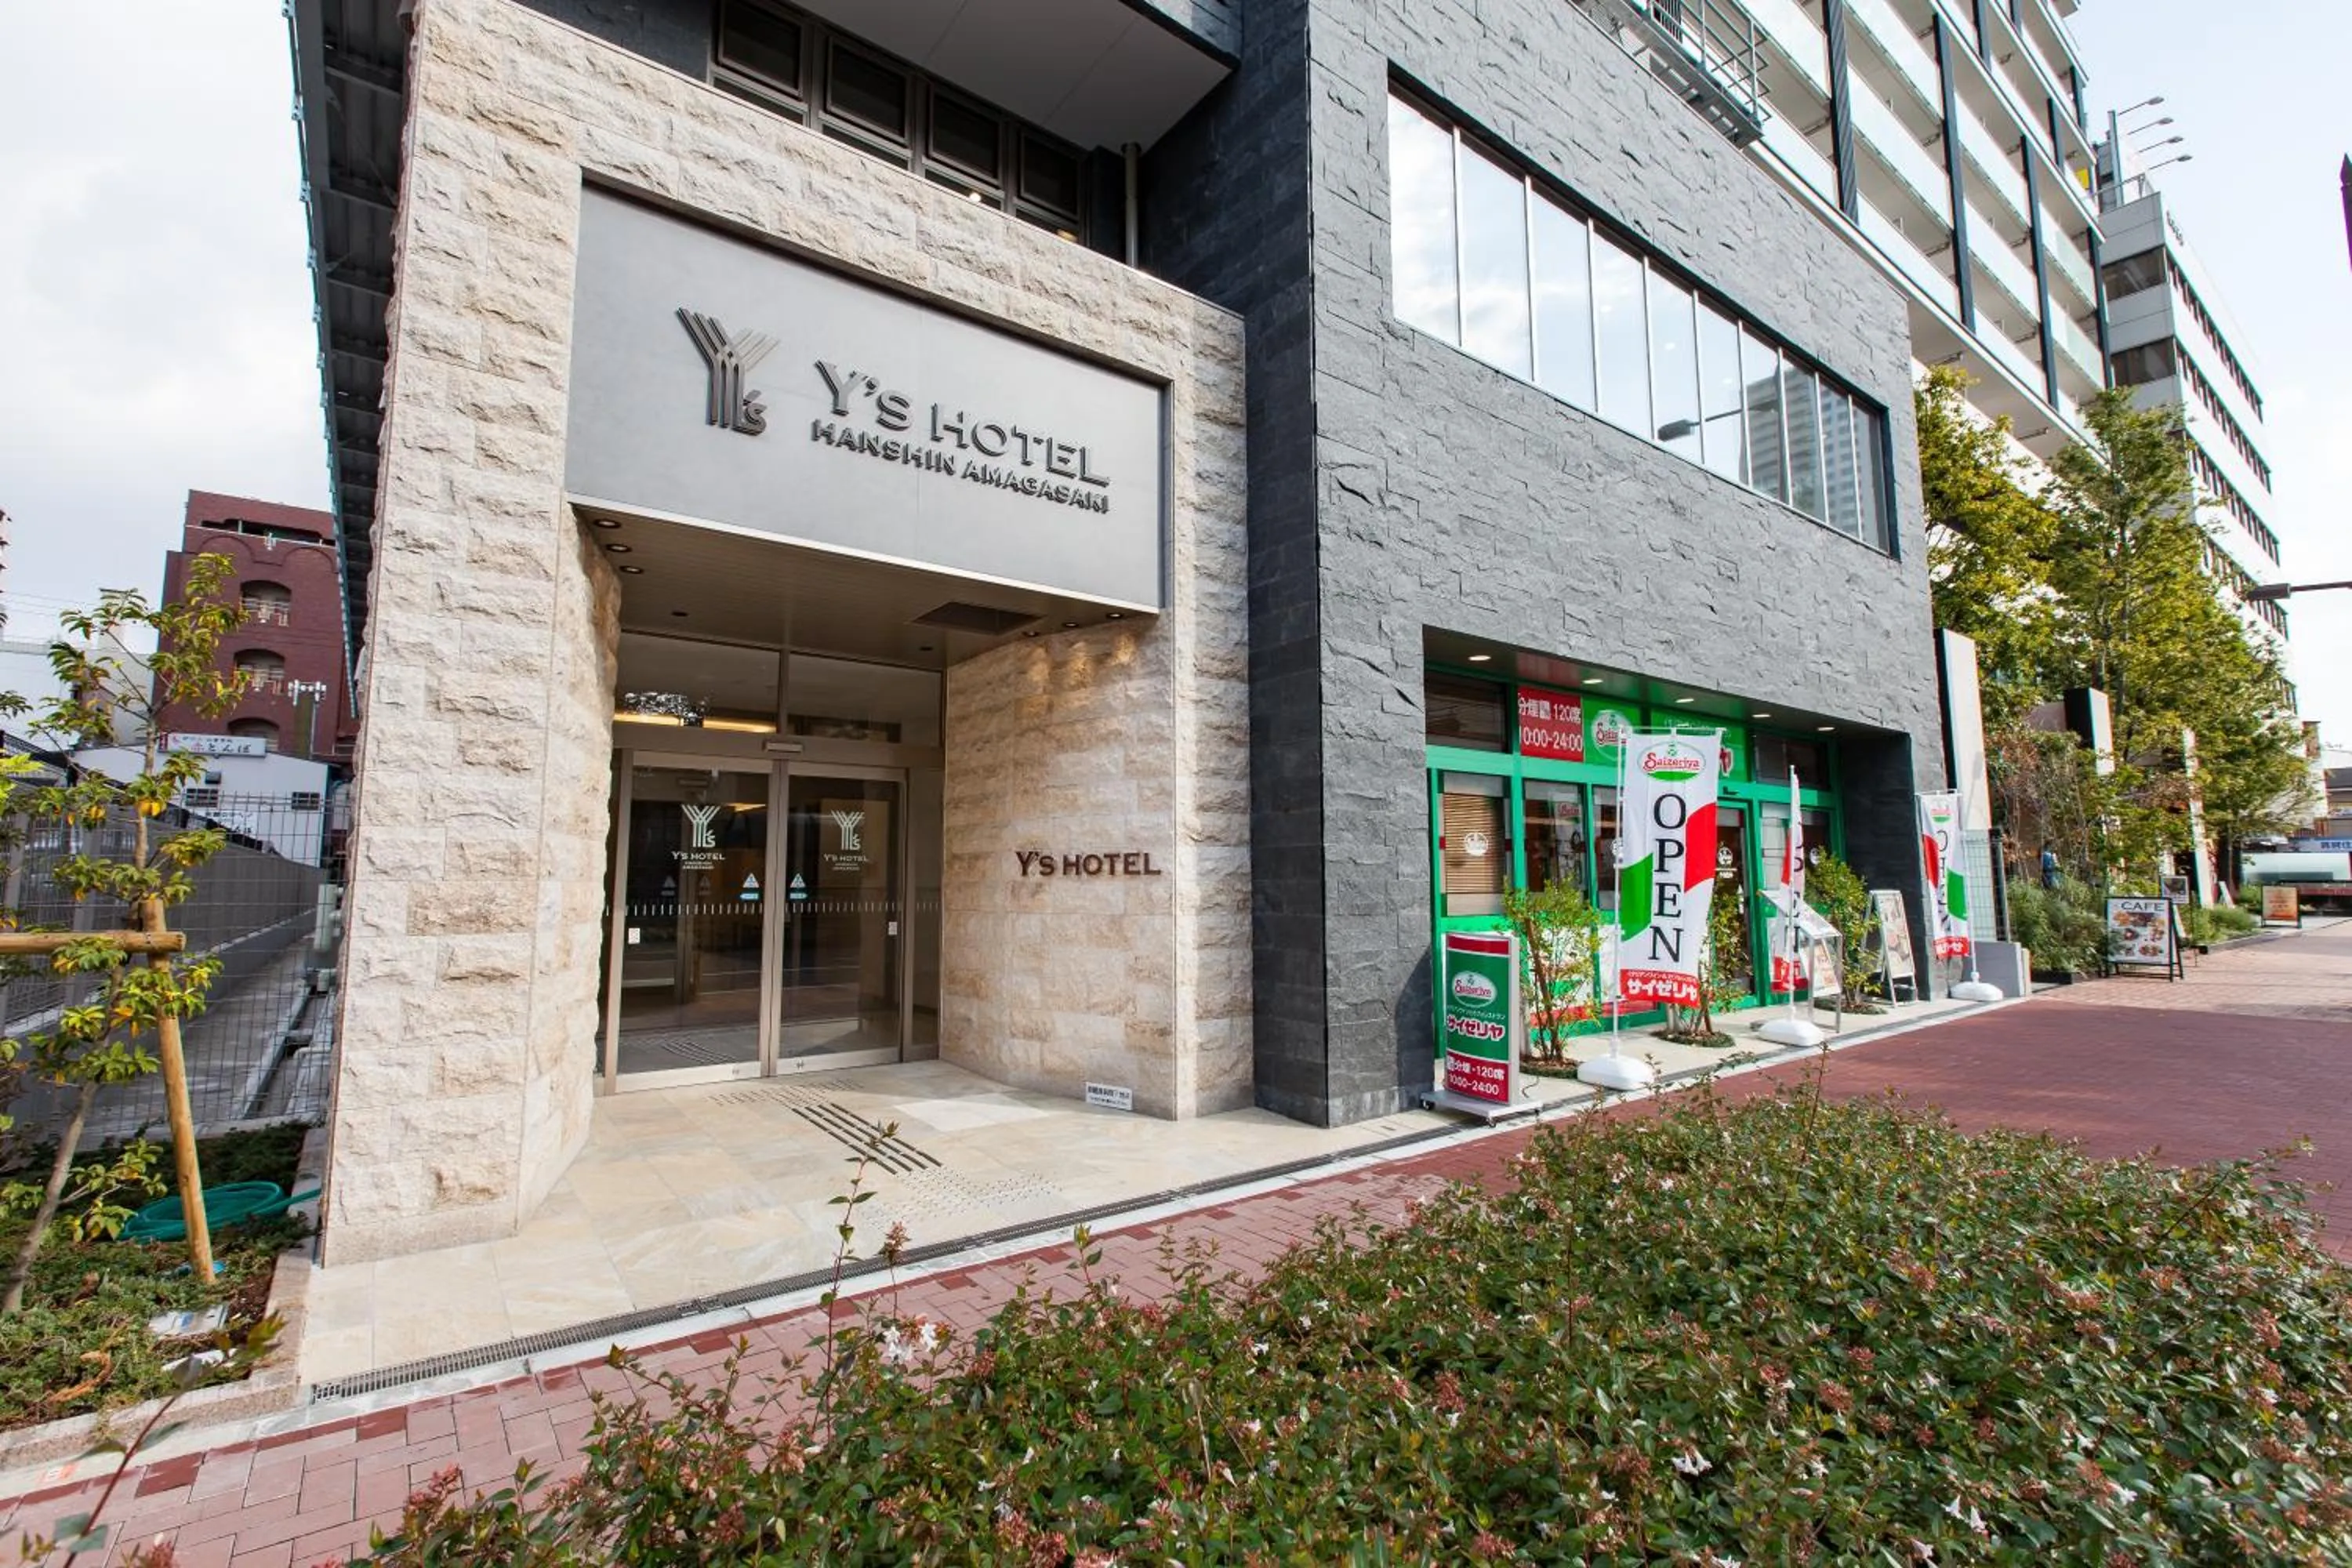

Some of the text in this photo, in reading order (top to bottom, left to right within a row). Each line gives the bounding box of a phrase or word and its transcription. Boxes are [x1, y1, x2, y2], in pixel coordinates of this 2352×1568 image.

[931, 402, 1110, 488] HOTEL
[811, 419, 1110, 514] HANSHIN AMAGASAKI
[1643, 752, 1700, 771] Saizeriya
[1062, 852, 1161, 876] HOTEL
[1648, 793, 1686, 963] OPEN
[2121, 901, 2165, 912] CAFE
[1628, 978, 1698, 1001] サイゼリヤ
[1447, 1014, 1505, 1041] サイゼリヤ
